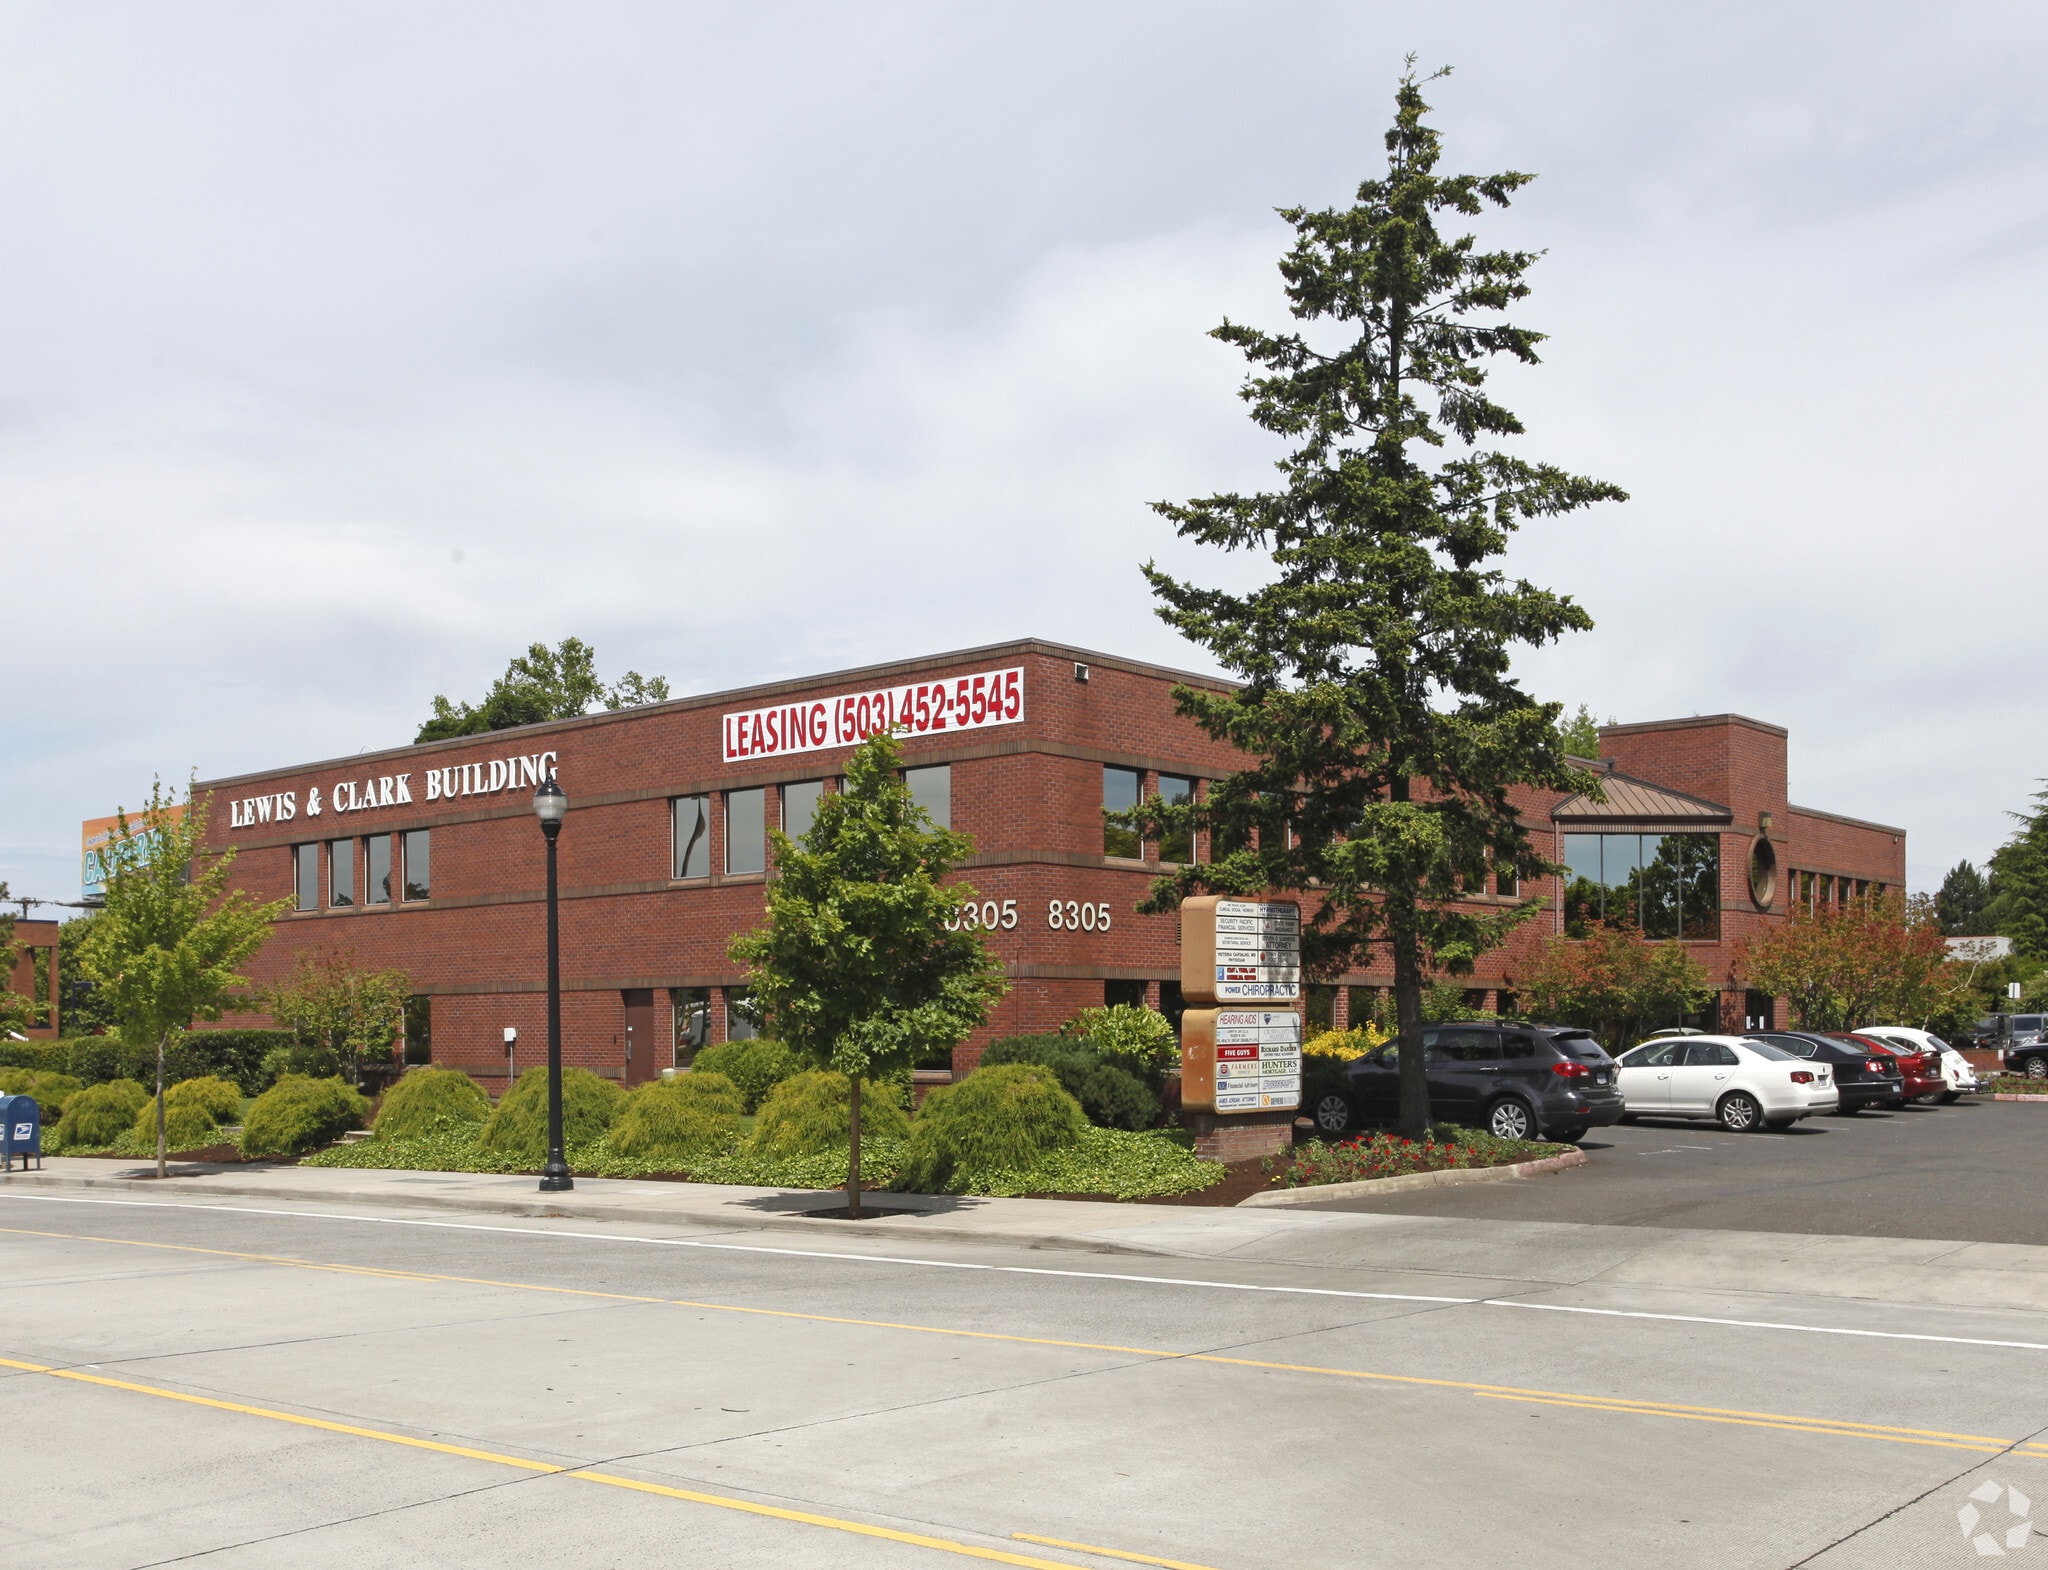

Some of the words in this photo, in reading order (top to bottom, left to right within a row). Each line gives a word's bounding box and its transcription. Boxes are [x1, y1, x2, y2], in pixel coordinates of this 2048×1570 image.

[726, 703, 826, 758] LEASING
[835, 692, 894, 743] (503)
[900, 671, 1020, 732] 452-5545
[230, 792, 296, 828] LEWIS
[306, 787, 322, 816] &
[333, 774, 412, 812] CLARK
[426, 751, 559, 800] BUILDING
[1049, 900, 1111, 931] 8305
[1242, 984, 1296, 995] CHIROPRACTIC
[1220, 1015, 1243, 1024] HEARING
[1244, 1014, 1257, 1024] AIDS
